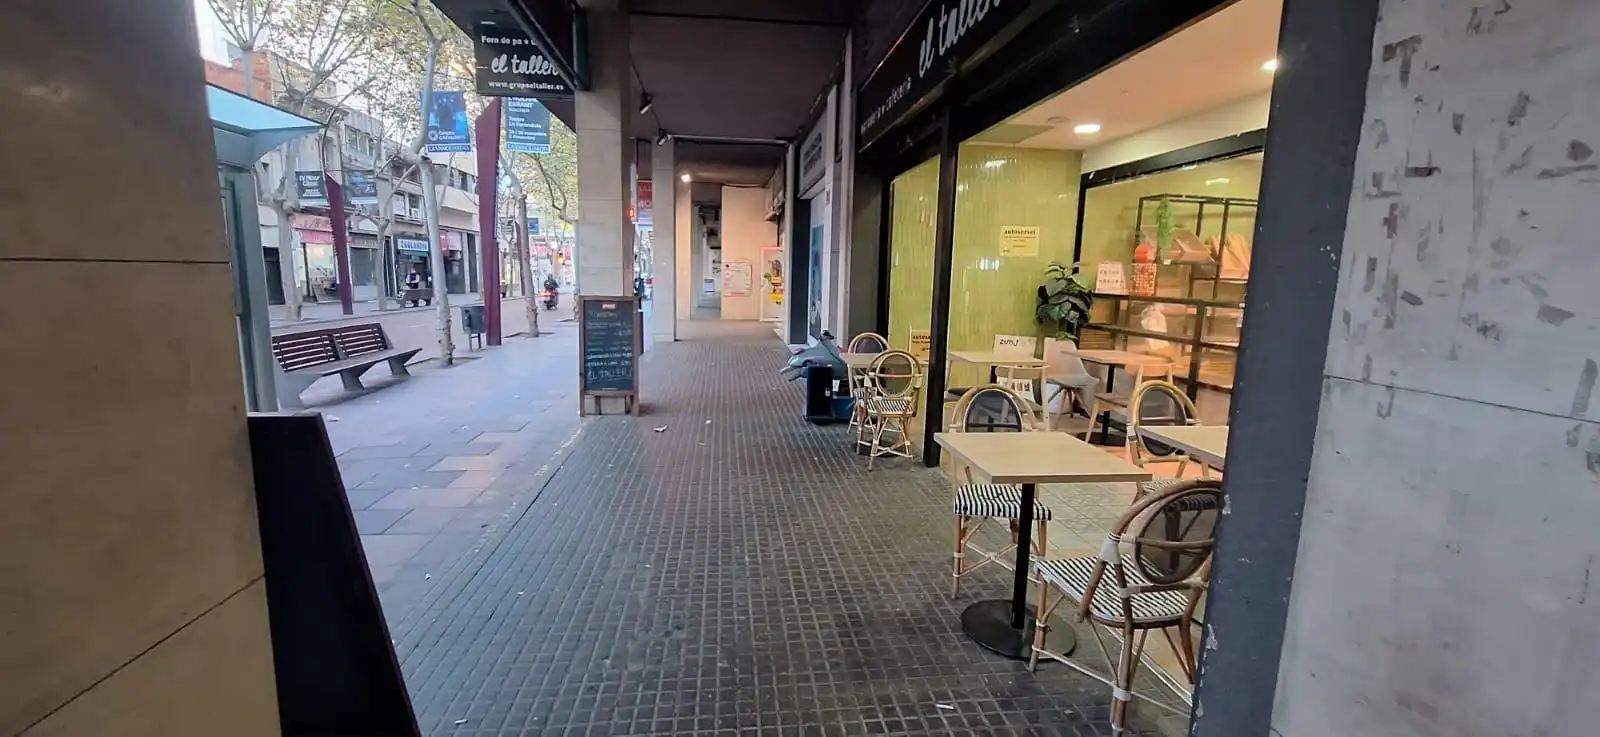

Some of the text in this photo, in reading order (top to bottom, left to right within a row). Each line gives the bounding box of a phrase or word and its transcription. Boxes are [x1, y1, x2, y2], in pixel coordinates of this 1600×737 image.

[481, 35, 499, 44] Forn
[500, 36, 511, 45] de
[512, 38, 523, 46] pa
[919, 17, 935, 78] el
[491, 53, 559, 75] el taller
[487, 81, 565, 91] www.grupoeltaller.es
